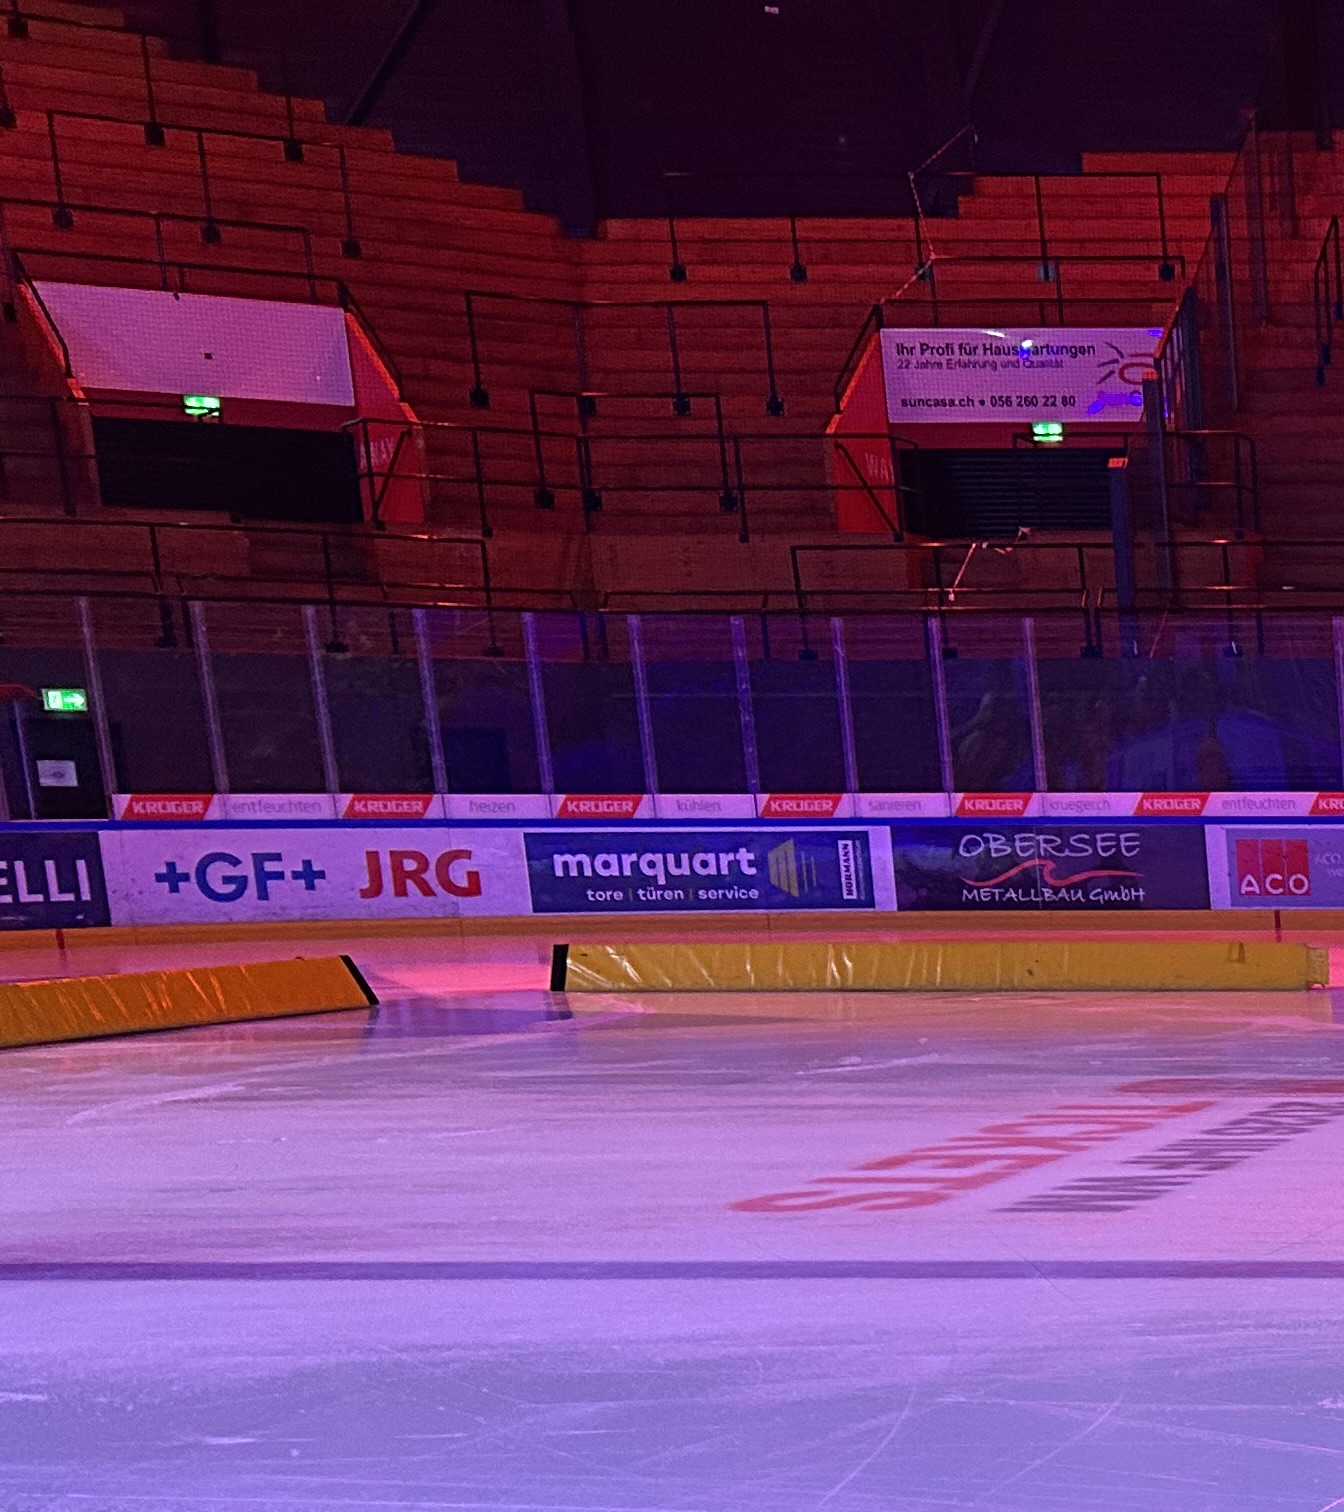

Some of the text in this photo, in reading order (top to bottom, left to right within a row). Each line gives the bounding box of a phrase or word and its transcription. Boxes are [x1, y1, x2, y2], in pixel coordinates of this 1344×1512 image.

[895, 341, 1096, 359] Ihr Profi für Hausartungen
[897, 359, 908, 370] 22
[913, 358, 943, 370] Jahre
[946, 358, 998, 372] Erfahrung
[1001, 358, 1021, 370] und
[901, 395, 975, 408] suncasa.ch
[1042, 395, 1058, 408] 22
[232, 800, 321, 815] entfeuchten
[1222, 796, 1297, 811] entfeuchten
[959, 832, 1141, 857] OBERSEE
[359, 849, 483, 900] JRG
[553, 847, 758, 886] marquart
[586, 885, 759, 901] tore türen service
[1240, 873, 1310, 895] ACO
[962, 885, 1146, 904] METALLBAU GmbH
[723, 1099, 1220, 1213] TICKETS
